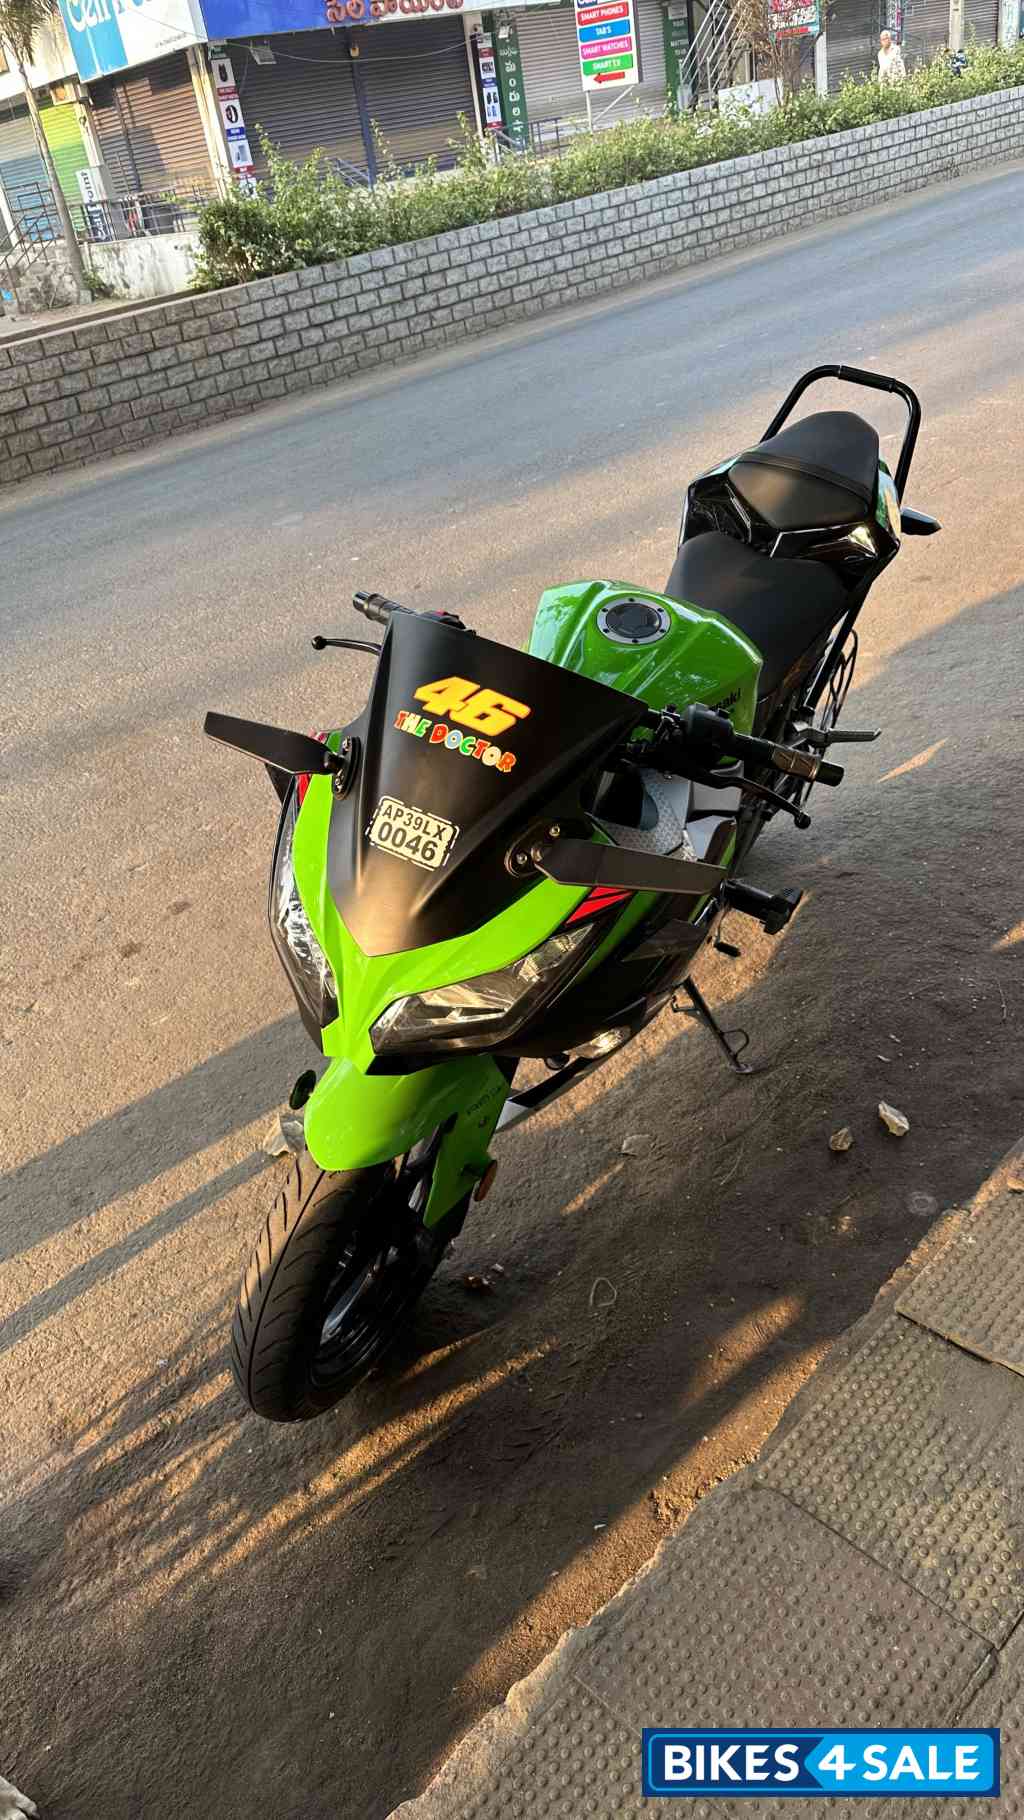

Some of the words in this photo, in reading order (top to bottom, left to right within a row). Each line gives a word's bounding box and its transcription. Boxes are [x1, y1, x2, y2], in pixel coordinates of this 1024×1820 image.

[581, 10, 599, 20] SMART
[601, 6, 624, 17] PHONES
[413, 676, 531, 737] 46
[394, 711, 432, 737] THE
[429, 723, 517, 773] DOCTOR
[377, 822, 437, 862] 0046
[382, 804, 448, 841] AP39LX
